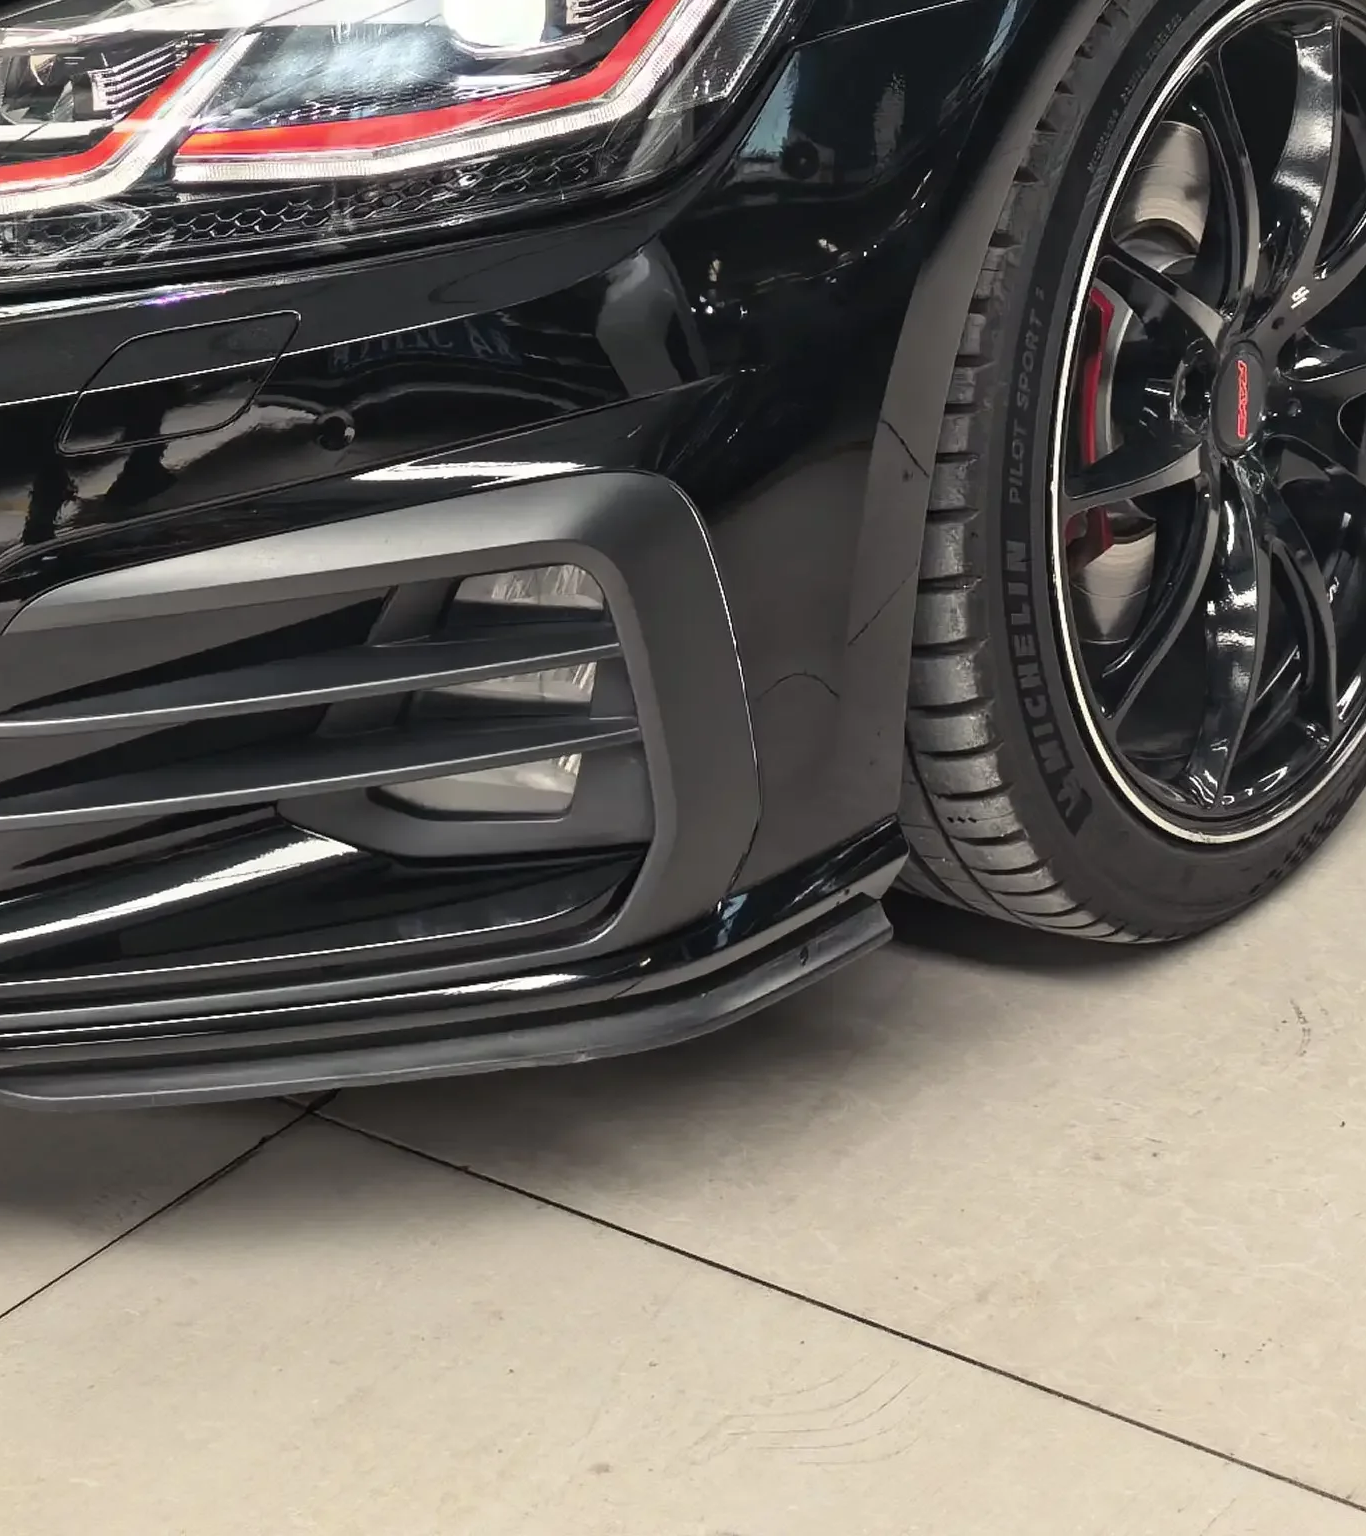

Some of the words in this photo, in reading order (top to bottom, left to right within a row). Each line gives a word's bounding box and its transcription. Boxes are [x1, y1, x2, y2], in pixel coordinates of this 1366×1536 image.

[1015, 308, 1044, 412] SPORT
[1008, 417, 1027, 505] PILOT
[1005, 539, 1070, 776] MICHELIN
